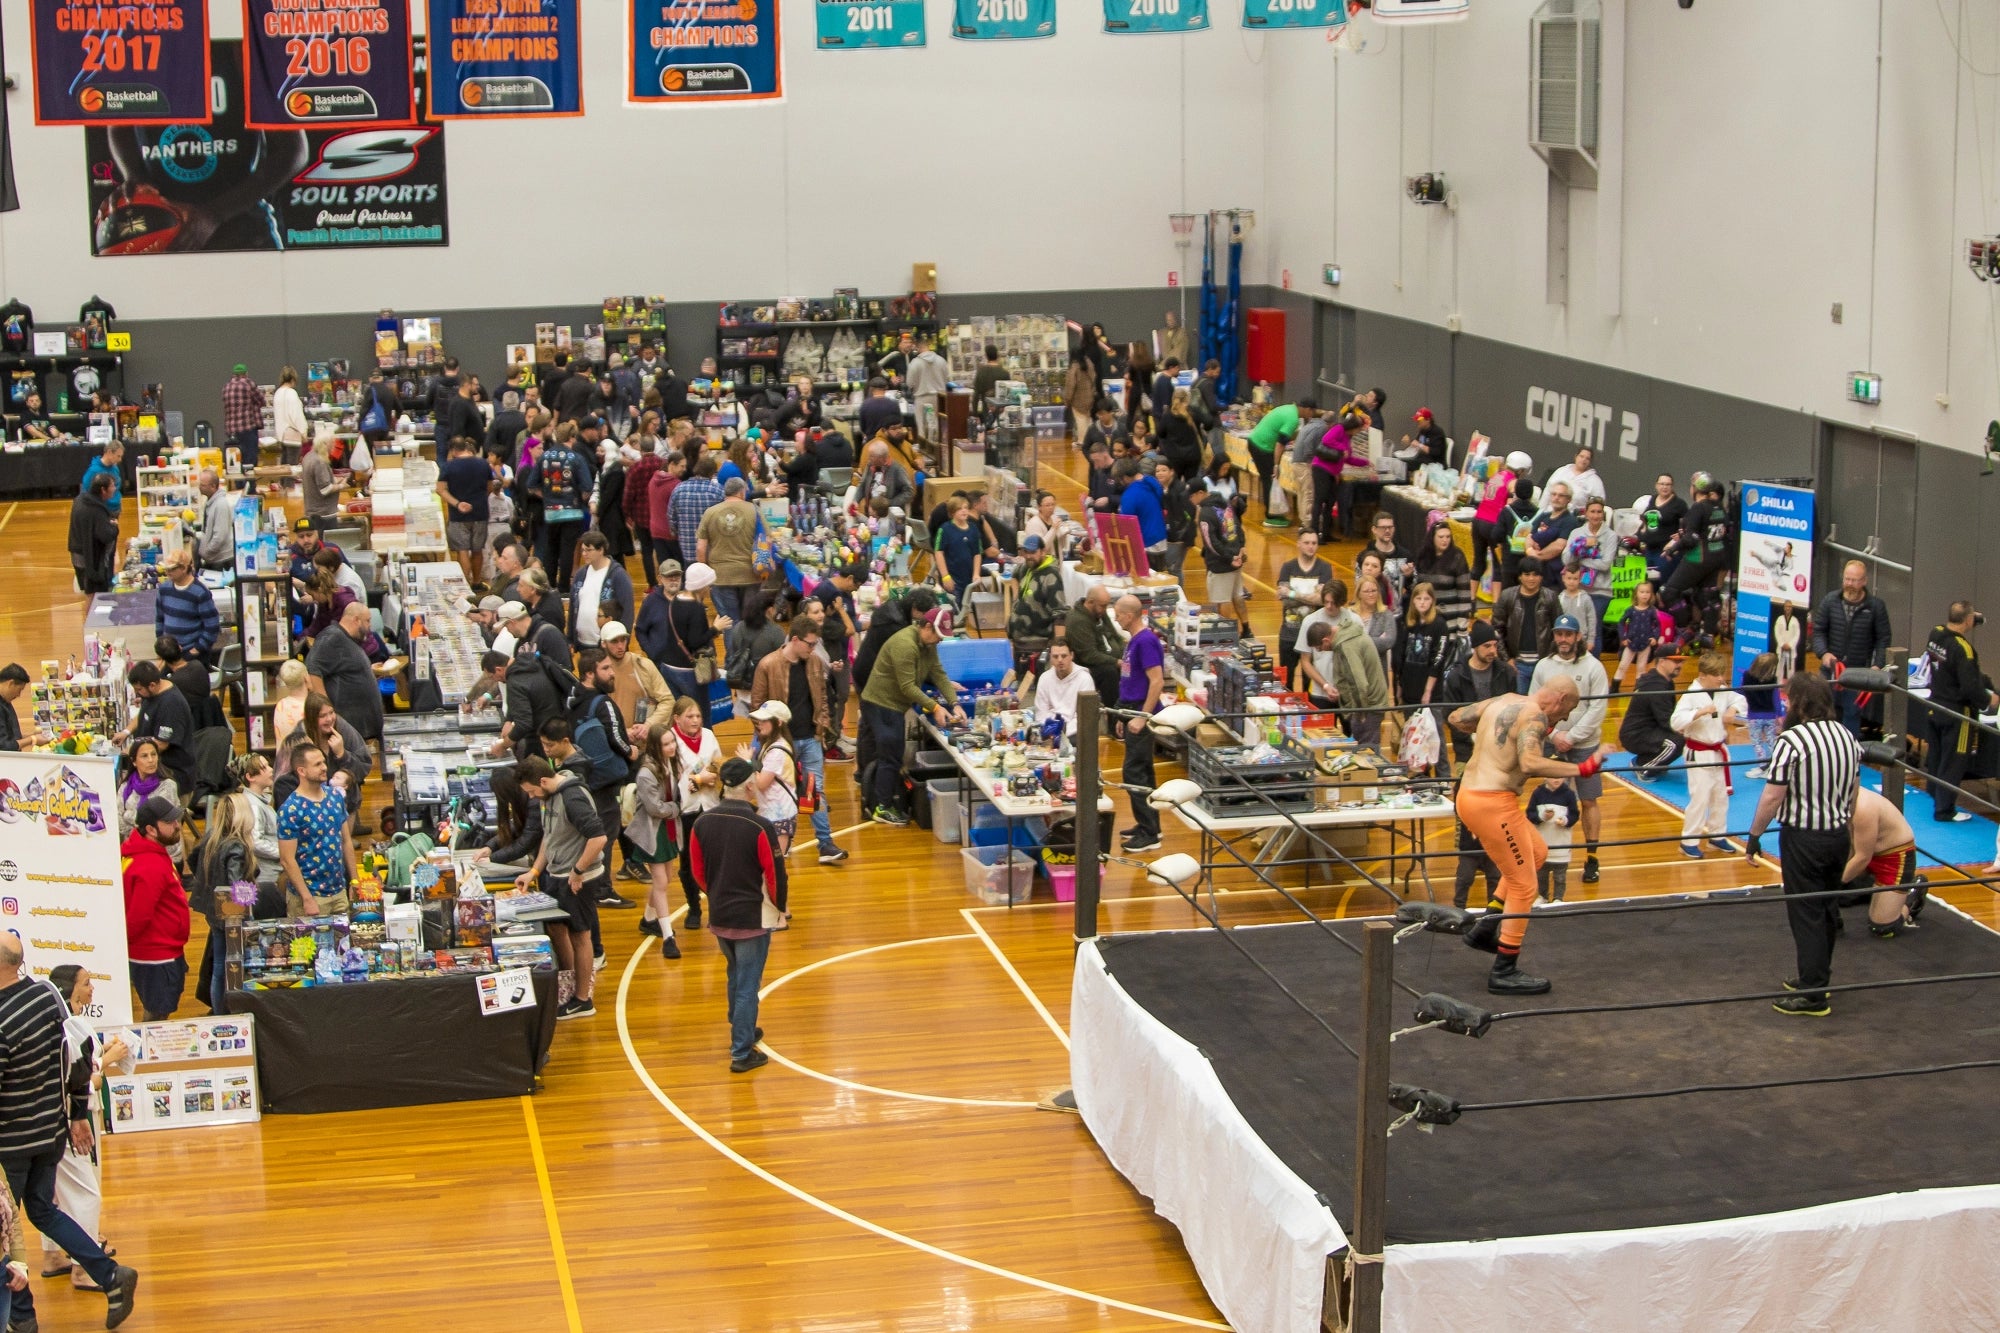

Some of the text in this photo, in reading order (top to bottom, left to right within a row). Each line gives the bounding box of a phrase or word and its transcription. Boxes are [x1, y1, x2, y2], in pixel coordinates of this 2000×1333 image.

[56, 7, 184, 31] CHAMPIONS
[662, 6, 699, 20] YOUTH
[847, 6, 893, 31] 2011
[977, 0, 1028, 22] 2010
[264, 9, 389, 36] CHAMPIONS
[451, 17, 559, 33] LEAGUE DIVISION 2
[650, 25, 758, 49] CHAMPIONS
[81, 35, 161, 71] 2017
[285, 37, 371, 76] 2016
[451, 37, 559, 63] CHAMPIONS
[686, 69, 734, 80] Basketball
[106, 90, 158, 102] Basketball
[486, 83, 534, 95] Basketball
[107, 101, 124, 110] NSW
[314, 94, 365, 106] Basketball
[315, 105, 331, 113] NSW
[142, 139, 238, 160] PANTHERS
[290, 184, 438, 205] SOUL SPORTS
[316, 208, 413, 226] Proud Partners
[1526, 386, 1641, 462] COURT 2
[1761, 496, 1794, 511] SHILLA
[1747, 512, 1808, 531] TAEKWONDO
